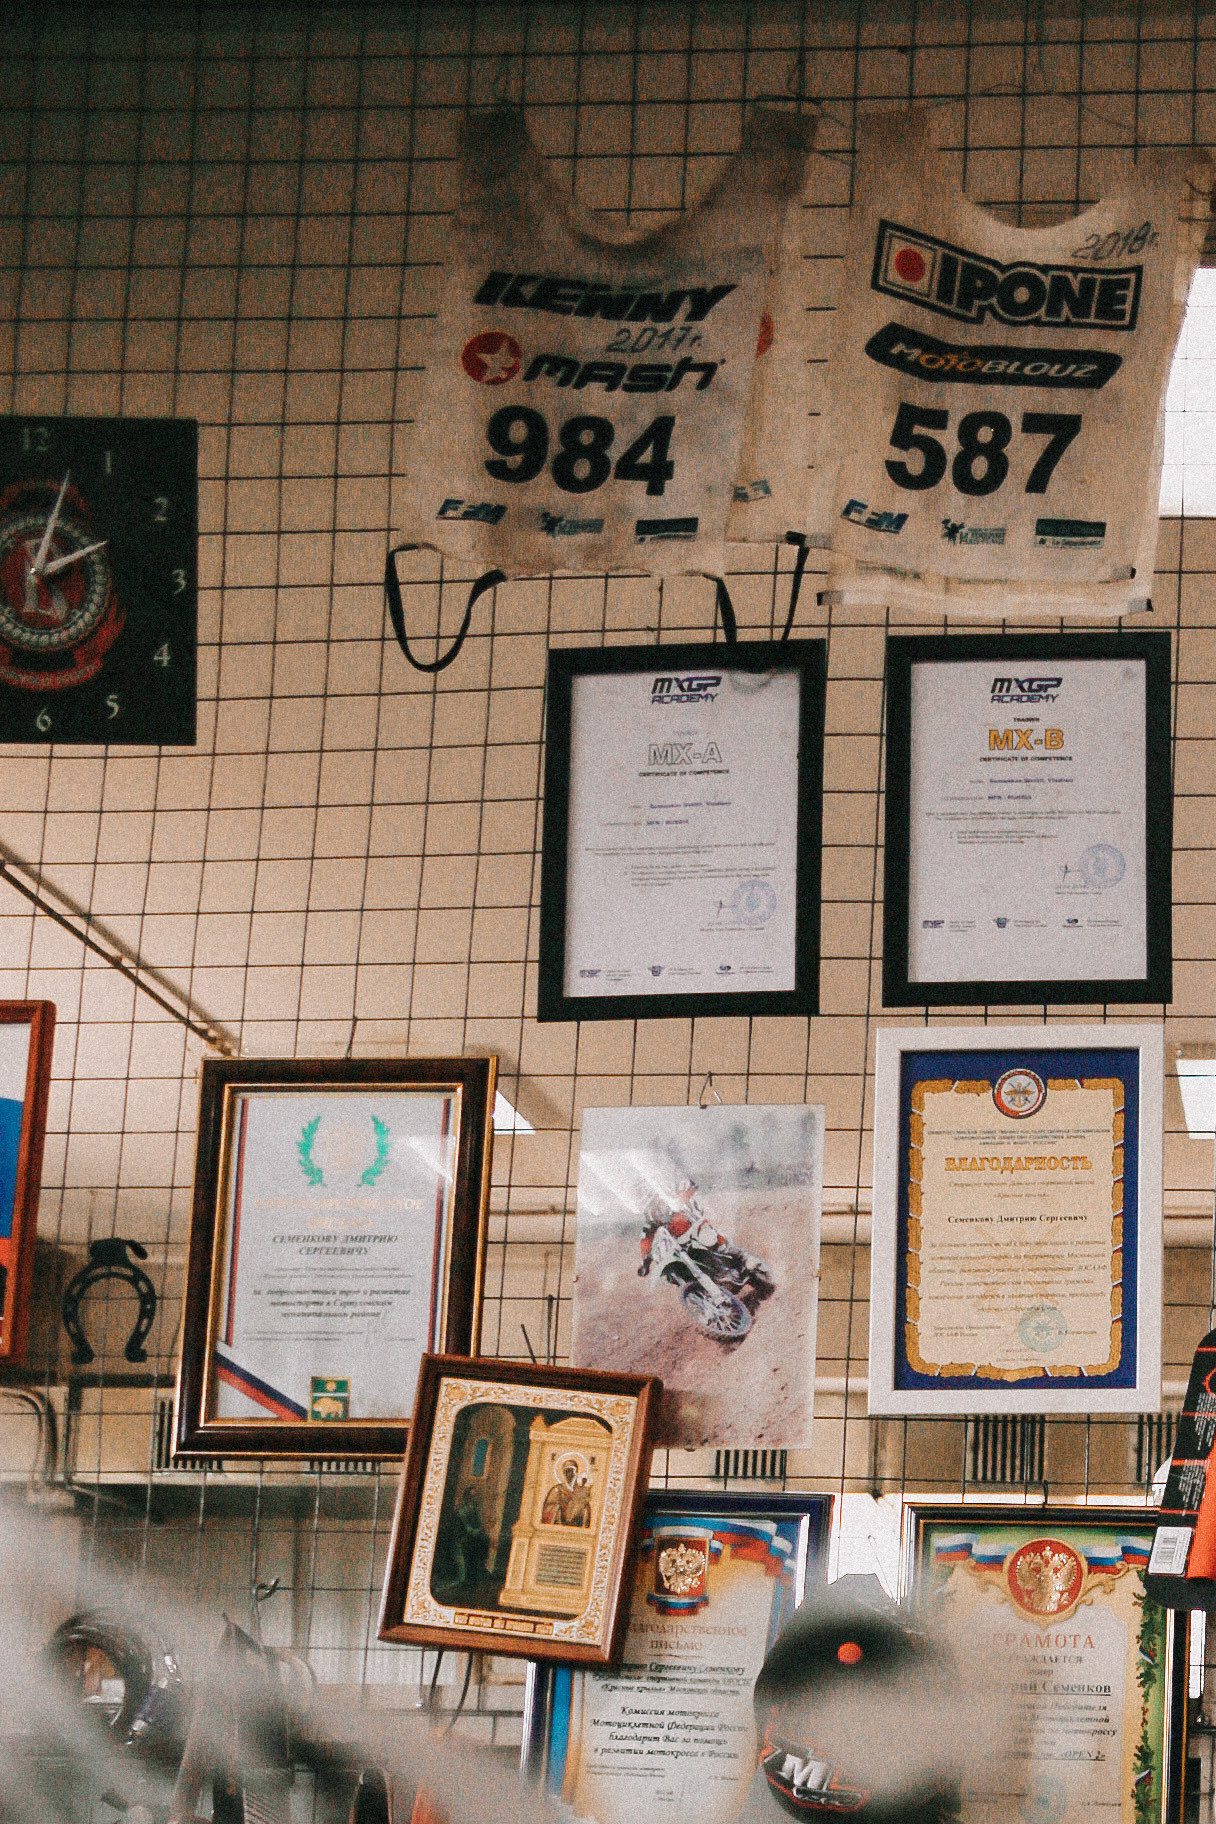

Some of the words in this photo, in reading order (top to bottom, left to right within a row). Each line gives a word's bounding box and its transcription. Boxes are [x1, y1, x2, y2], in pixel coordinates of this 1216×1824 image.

[473, 271, 737, 322] KENNY
[935, 253, 1134, 325] IPONE
[22, 427, 49, 451] 12
[484, 405, 676, 496] 984
[885, 401, 1082, 495] 587
[154, 497, 169, 521] 2
[172, 569, 187, 594] 3
[154, 643, 170, 667] 4
[651, 676, 722, 694] MXGP
[991, 677, 1063, 694] MXGP
[106, 694, 119, 719] 5
[651, 693, 719, 705] ACADEMY
[990, 693, 1060, 703] ACADEMY
[36, 708, 51, 731] 6
[988, 728, 1065, 751] MX-B
[648, 742, 722, 766] MX-A
[944, 1155, 1093, 1174] БЛАГОДАРНОСТЬ
